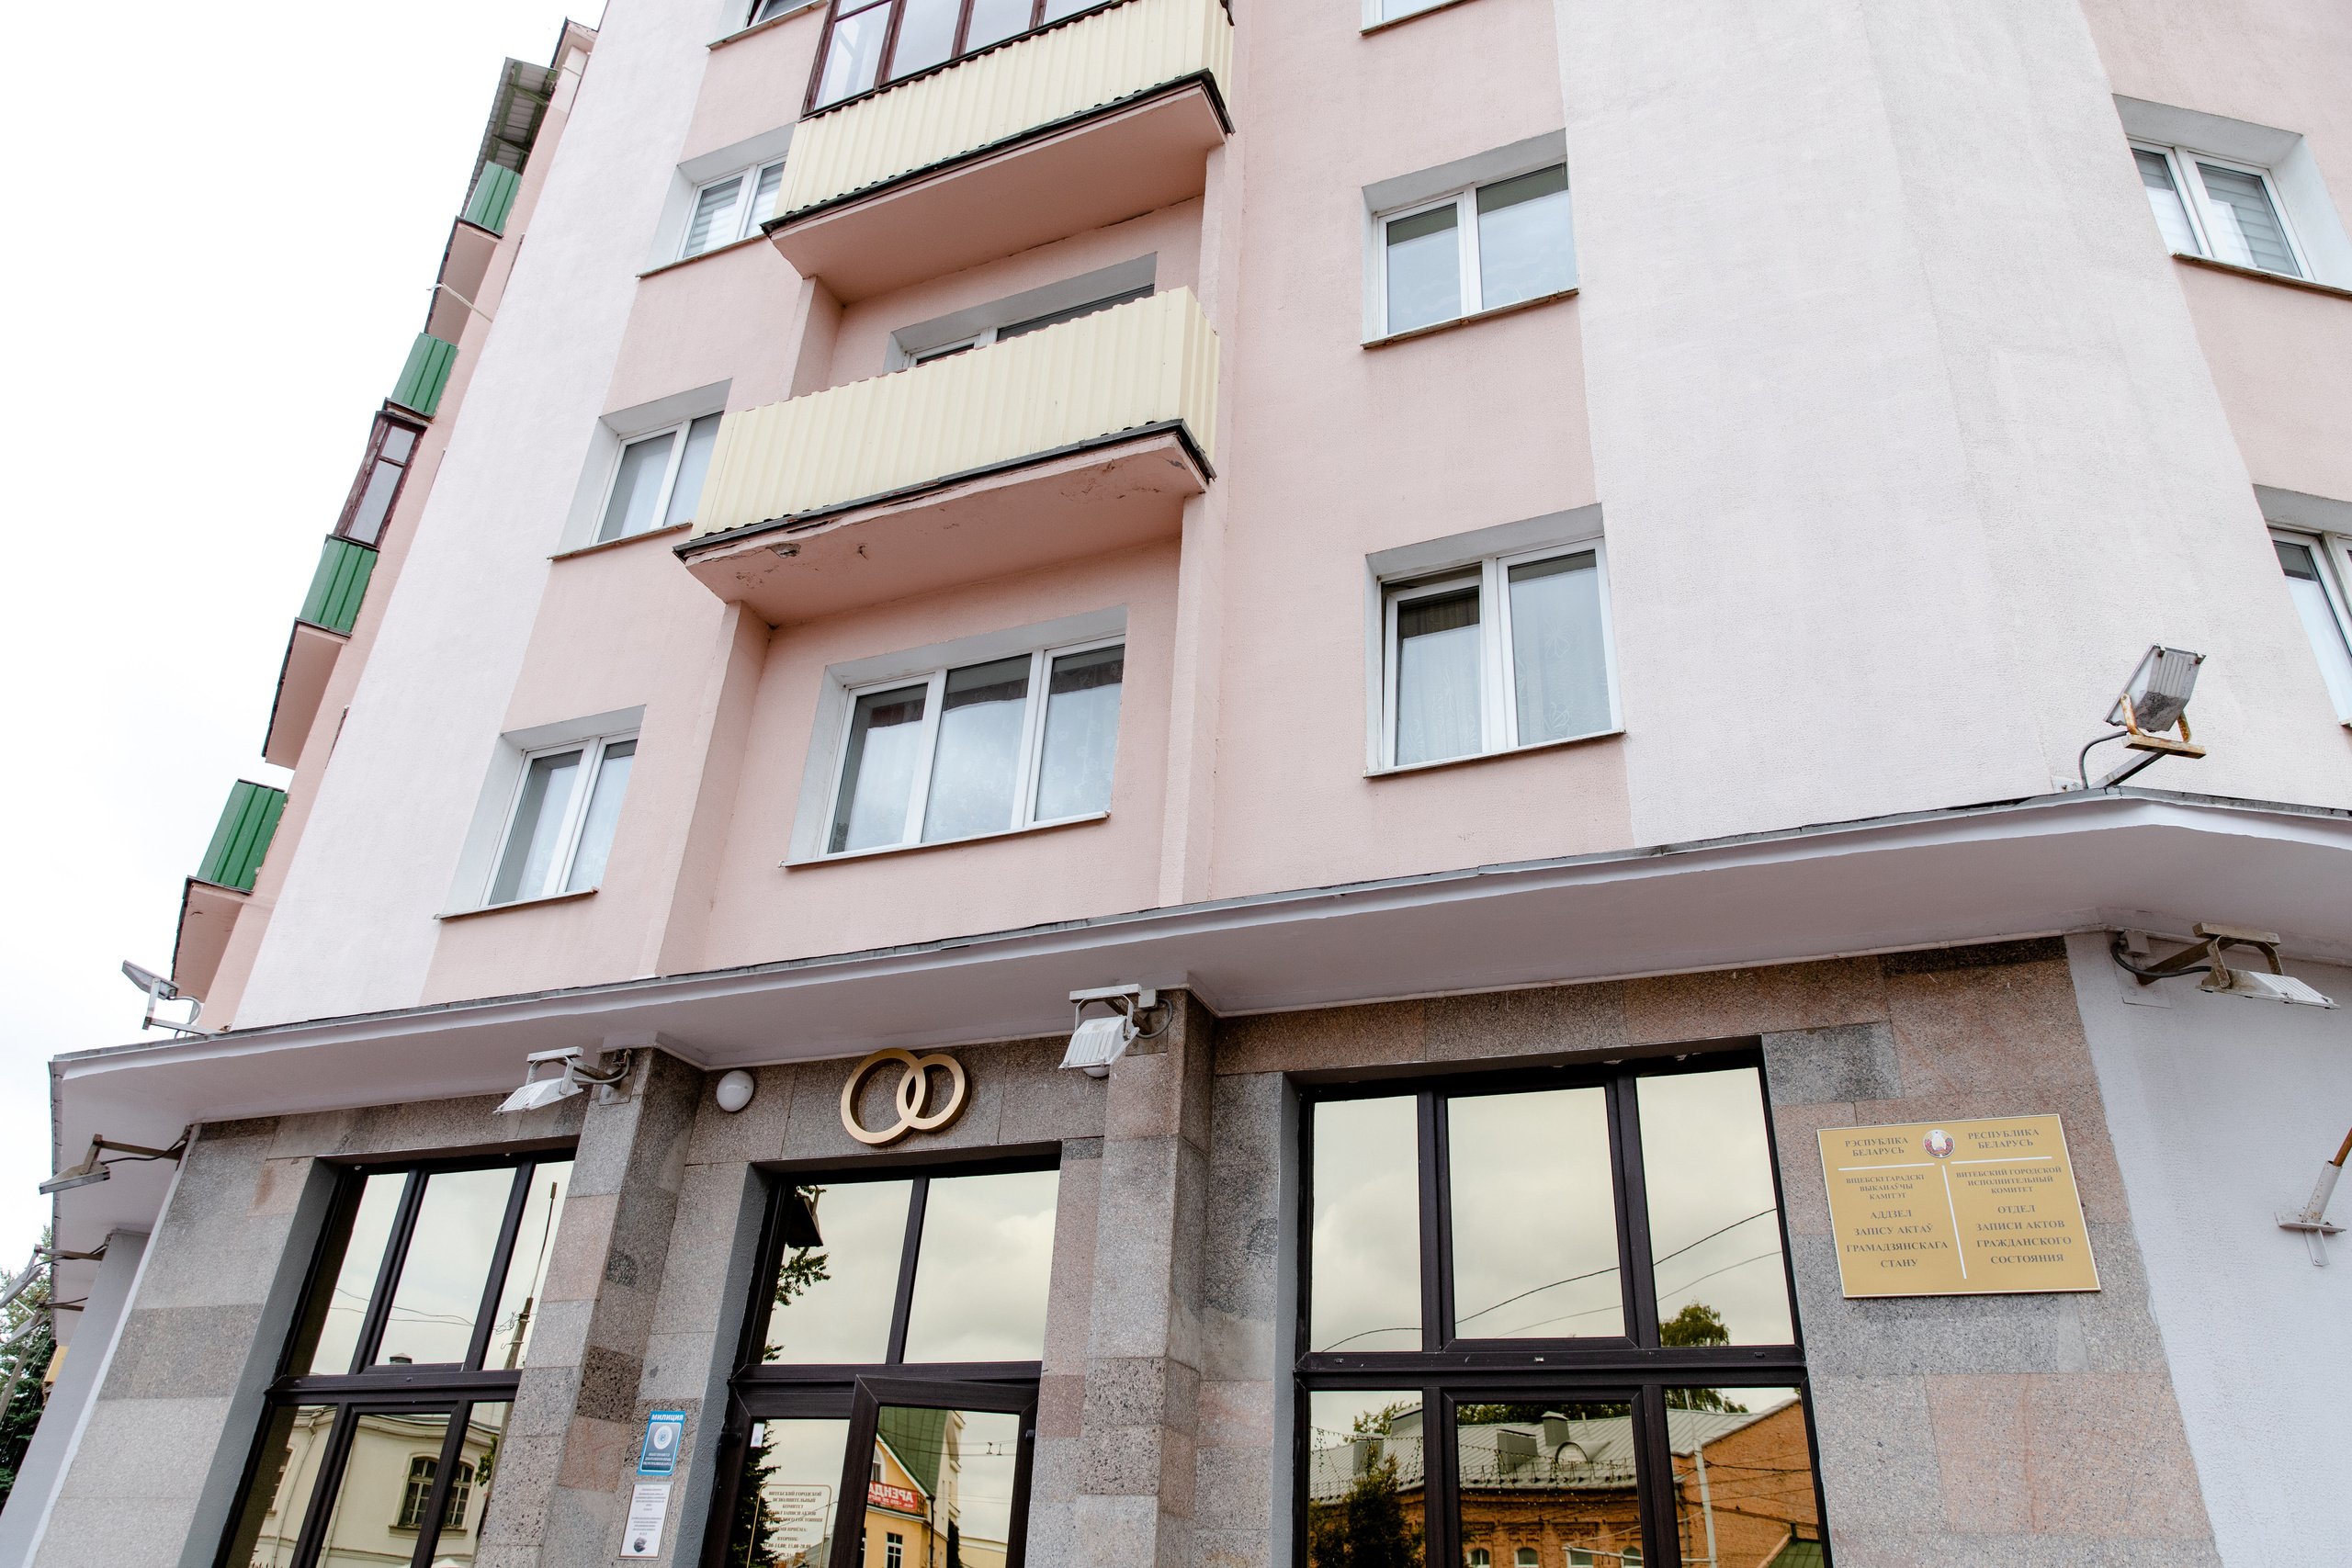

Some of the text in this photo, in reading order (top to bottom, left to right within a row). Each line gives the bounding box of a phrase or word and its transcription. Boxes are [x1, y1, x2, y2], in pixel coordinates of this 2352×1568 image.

[1968, 1129, 2040, 1139] РЕСПУБЛИКА
[1845, 1137, 1908, 1147] РЭСПУБЛІКА
[1978, 1139, 2033, 1149] БЕЛАРУСЬ
[1852, 1146, 1905, 1156] БЕЛАРУСЬ
[1956, 1166, 2062, 1178] ВИТЕБСКИЙ ГОРОДСКОЙ
[1968, 1176, 2053, 1186] ИСПОЛНИТЕЛЬНЫЙ
[1860, 1183, 1913, 1191] ВЫКАНАЎЧЫ
[1871, 1209, 1912, 1219] АДДЗЕЛ
[1997, 1205, 2036, 1214] ОТДЕЛ
[1854, 1223, 1933, 1235] ЗАПІСУ АКТАЎ
[1975, 1220, 2065, 1231] ЗАПИСИ АКТОВ
[1976, 1236, 2072, 1247] ГРАЖДАНСКОГО
[1847, 1241, 1948, 1253] ГРАМАДЗЯНСКАГА
[1881, 1258, 1918, 1268] СТАНУ
[1991, 1253, 2064, 1264] СОСТОЯНИЯ
[651, 1414, 684, 1422] МИЛИЦИЯ
